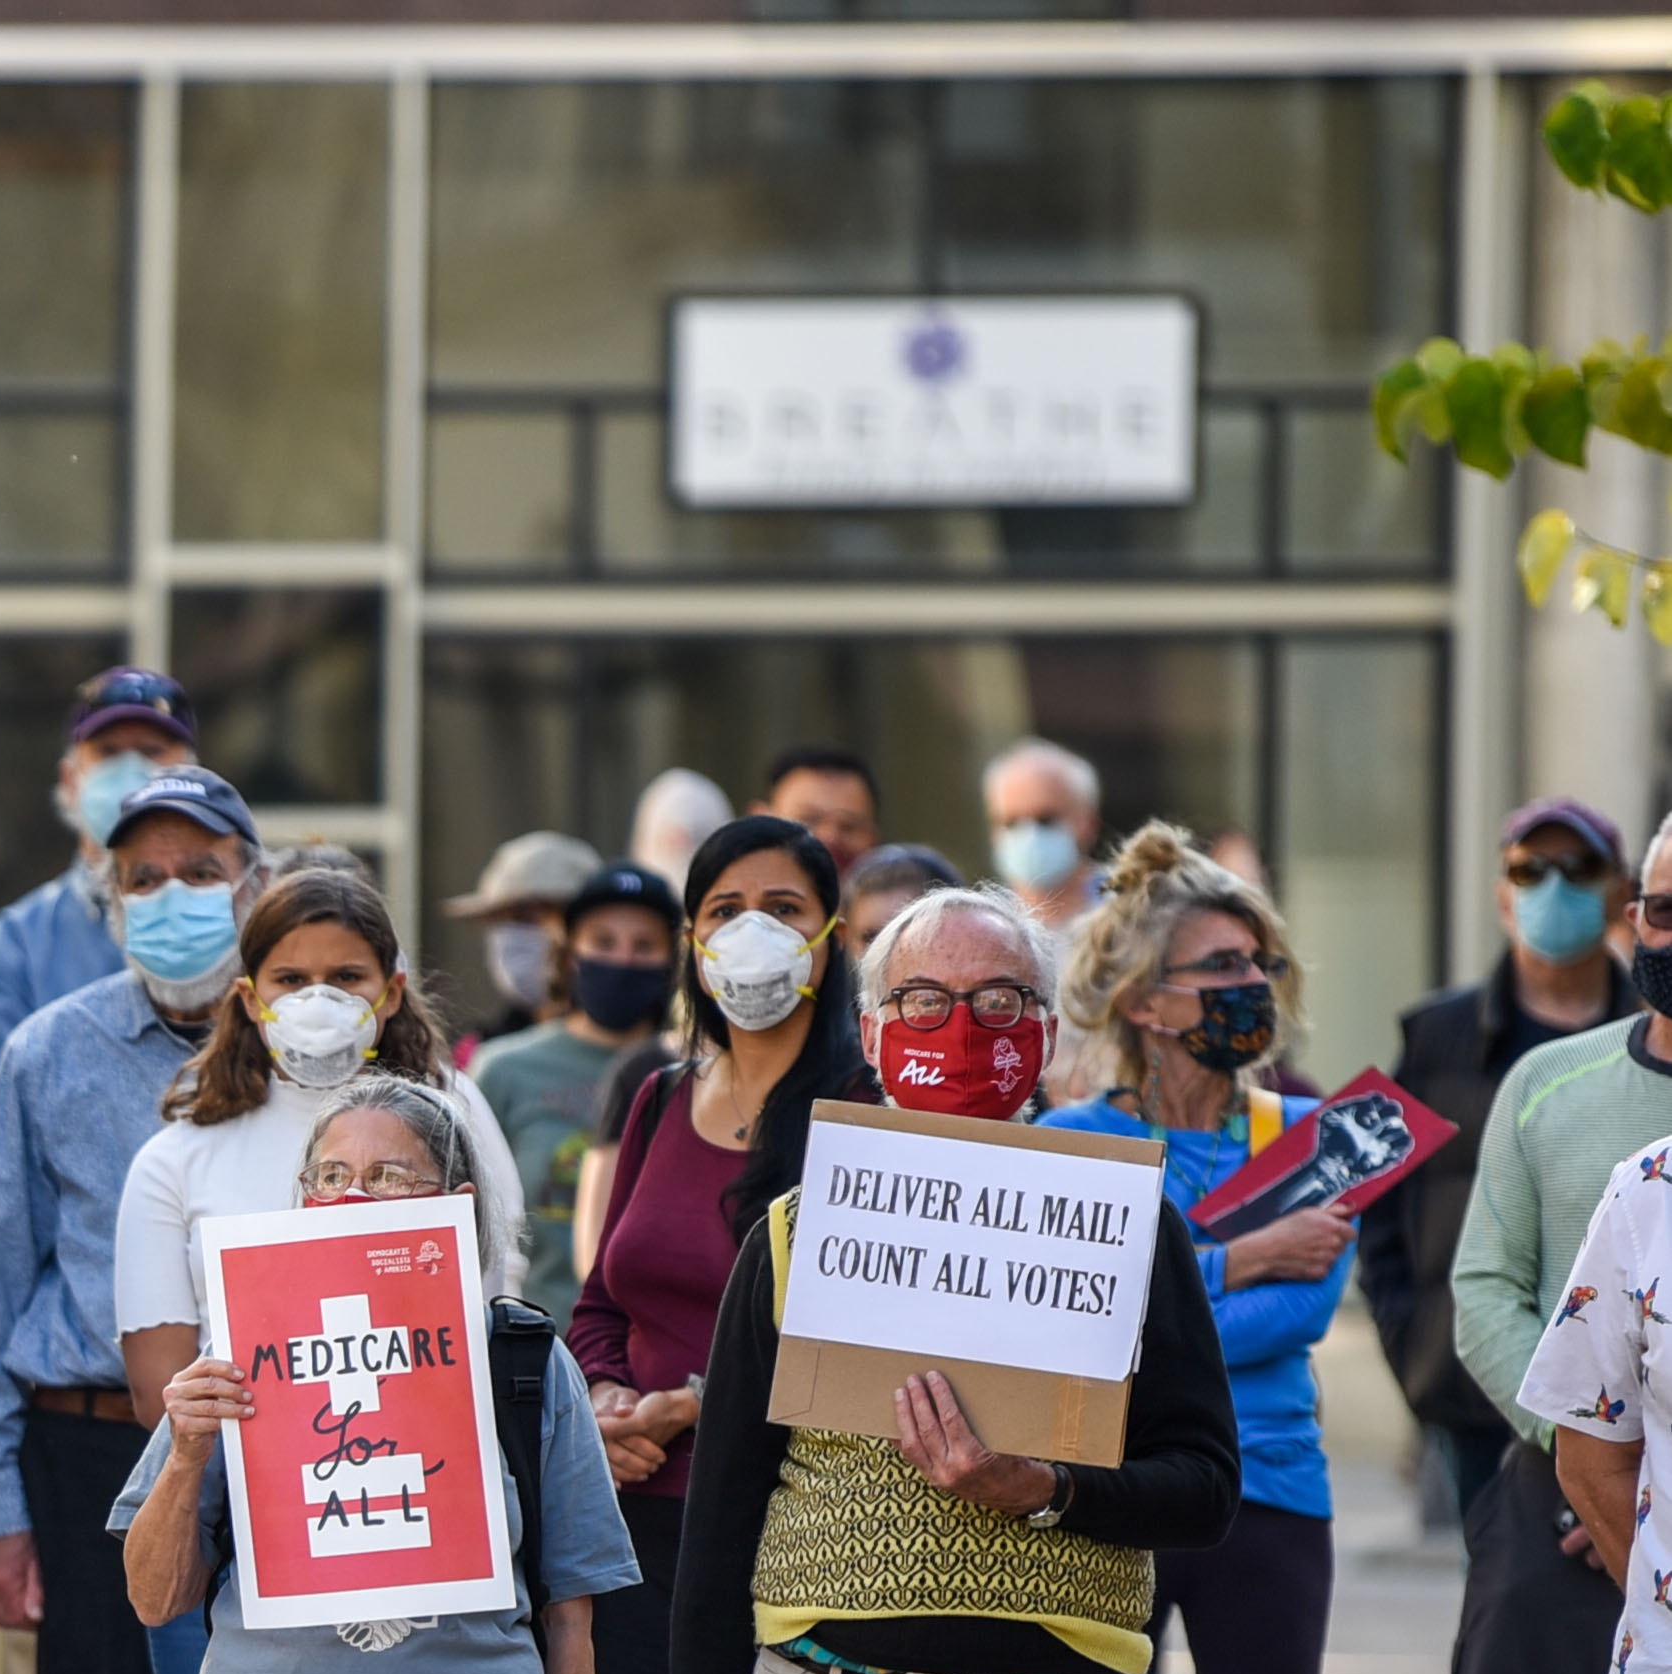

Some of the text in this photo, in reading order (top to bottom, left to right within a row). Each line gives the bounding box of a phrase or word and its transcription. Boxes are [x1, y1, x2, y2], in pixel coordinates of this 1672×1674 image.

[898, 1058, 945, 1086] ALL
[932, 1051, 945, 1059] FOR
[827, 1165, 1131, 1247] DELIVER ALL MAIL!
[818, 1235, 1117, 1317] COUNT ALL VOTES!
[251, 1326, 456, 1382] MEDICARE
[317, 1483, 424, 1531] ALL
